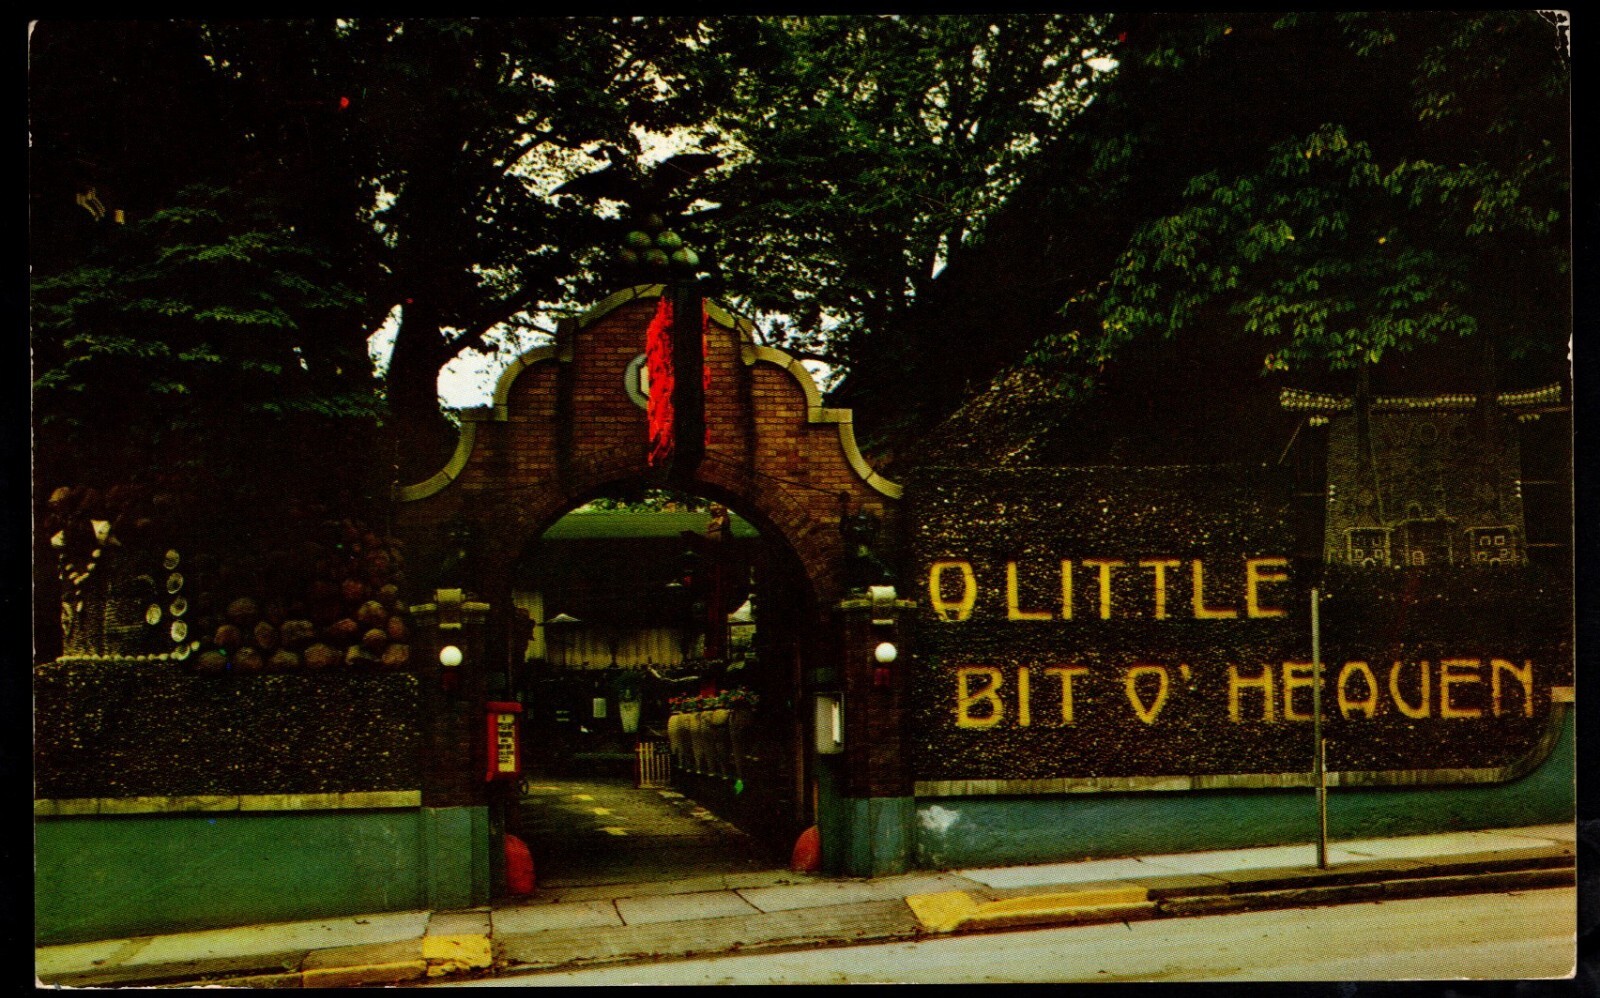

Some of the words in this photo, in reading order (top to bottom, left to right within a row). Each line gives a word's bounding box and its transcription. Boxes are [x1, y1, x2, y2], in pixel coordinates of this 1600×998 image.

[1007, 559, 1288, 620] LITTLE
[957, 665, 1089, 727] BIT
[1126, 664, 1191, 724] O'
